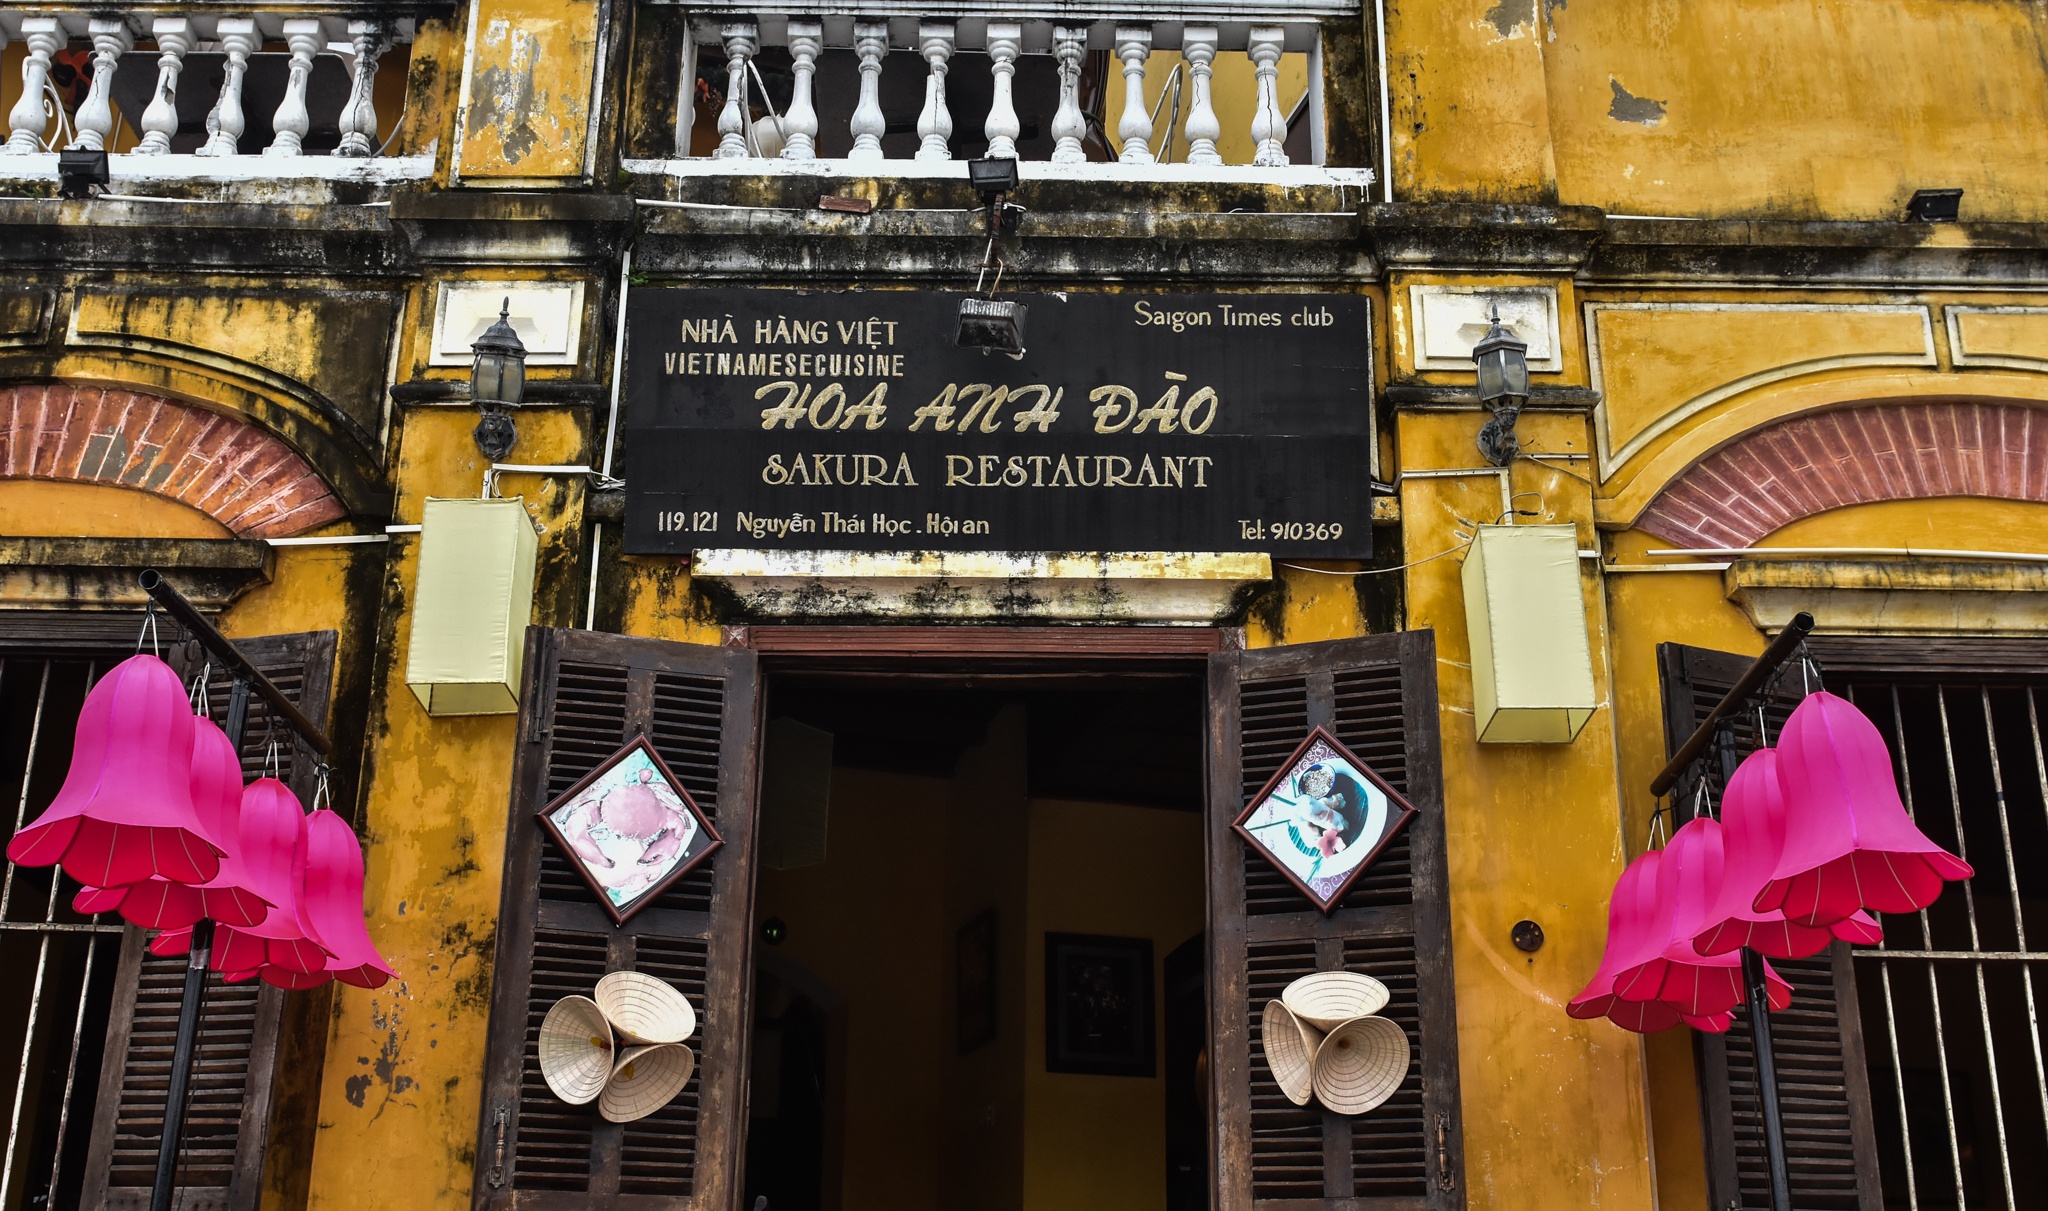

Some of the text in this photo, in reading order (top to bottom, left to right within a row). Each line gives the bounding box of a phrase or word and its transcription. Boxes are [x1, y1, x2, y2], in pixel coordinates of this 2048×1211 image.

[755, 315, 829, 345] HÀNG
[837, 316, 899, 350] VIỆT
[1134, 300, 1334, 333] Saigon Times club
[754, 380, 889, 431] HOA
[908, 382, 1064, 434] ANH
[762, 452, 1213, 489] SAKURA RESTAURANT
[737, 512, 816, 539] Nguyễn
[822, 511, 866, 534] Thái
[873, 512, 912, 538] Học
[926, 512, 959, 538] Hội
[1238, 518, 1343, 541] Tel: 910369
